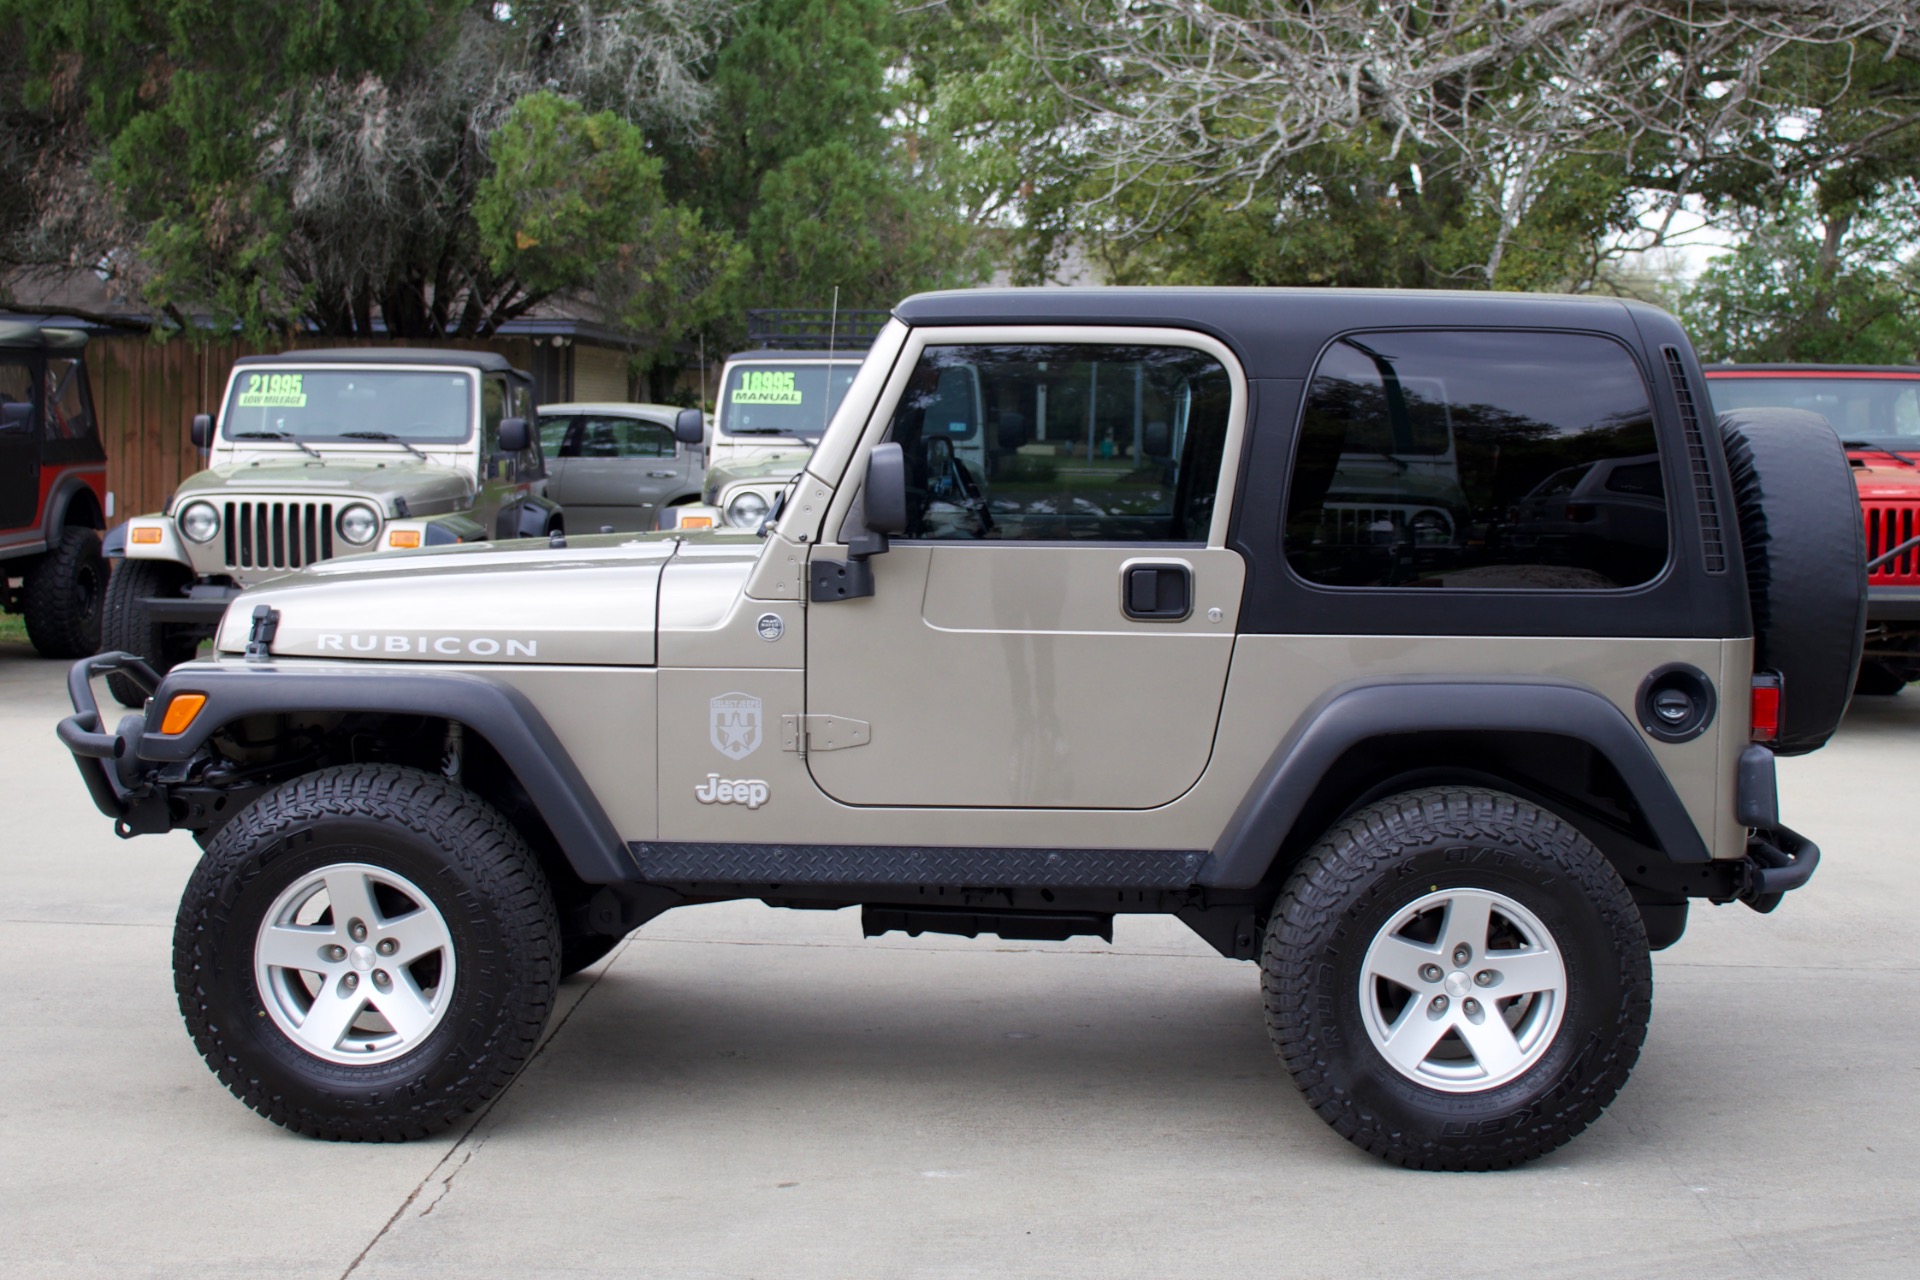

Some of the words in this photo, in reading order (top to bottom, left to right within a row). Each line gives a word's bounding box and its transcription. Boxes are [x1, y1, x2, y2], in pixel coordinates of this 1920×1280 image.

[248, 374, 303, 394] 21995
[742, 371, 795, 391] 18995
[243, 396, 263, 404] LOW
[264, 396, 302, 404] MILEAGE
[735, 392, 798, 401] MANUAL
[317, 634, 538, 656] RUBICON
[695, 773, 770, 809] Jeep
